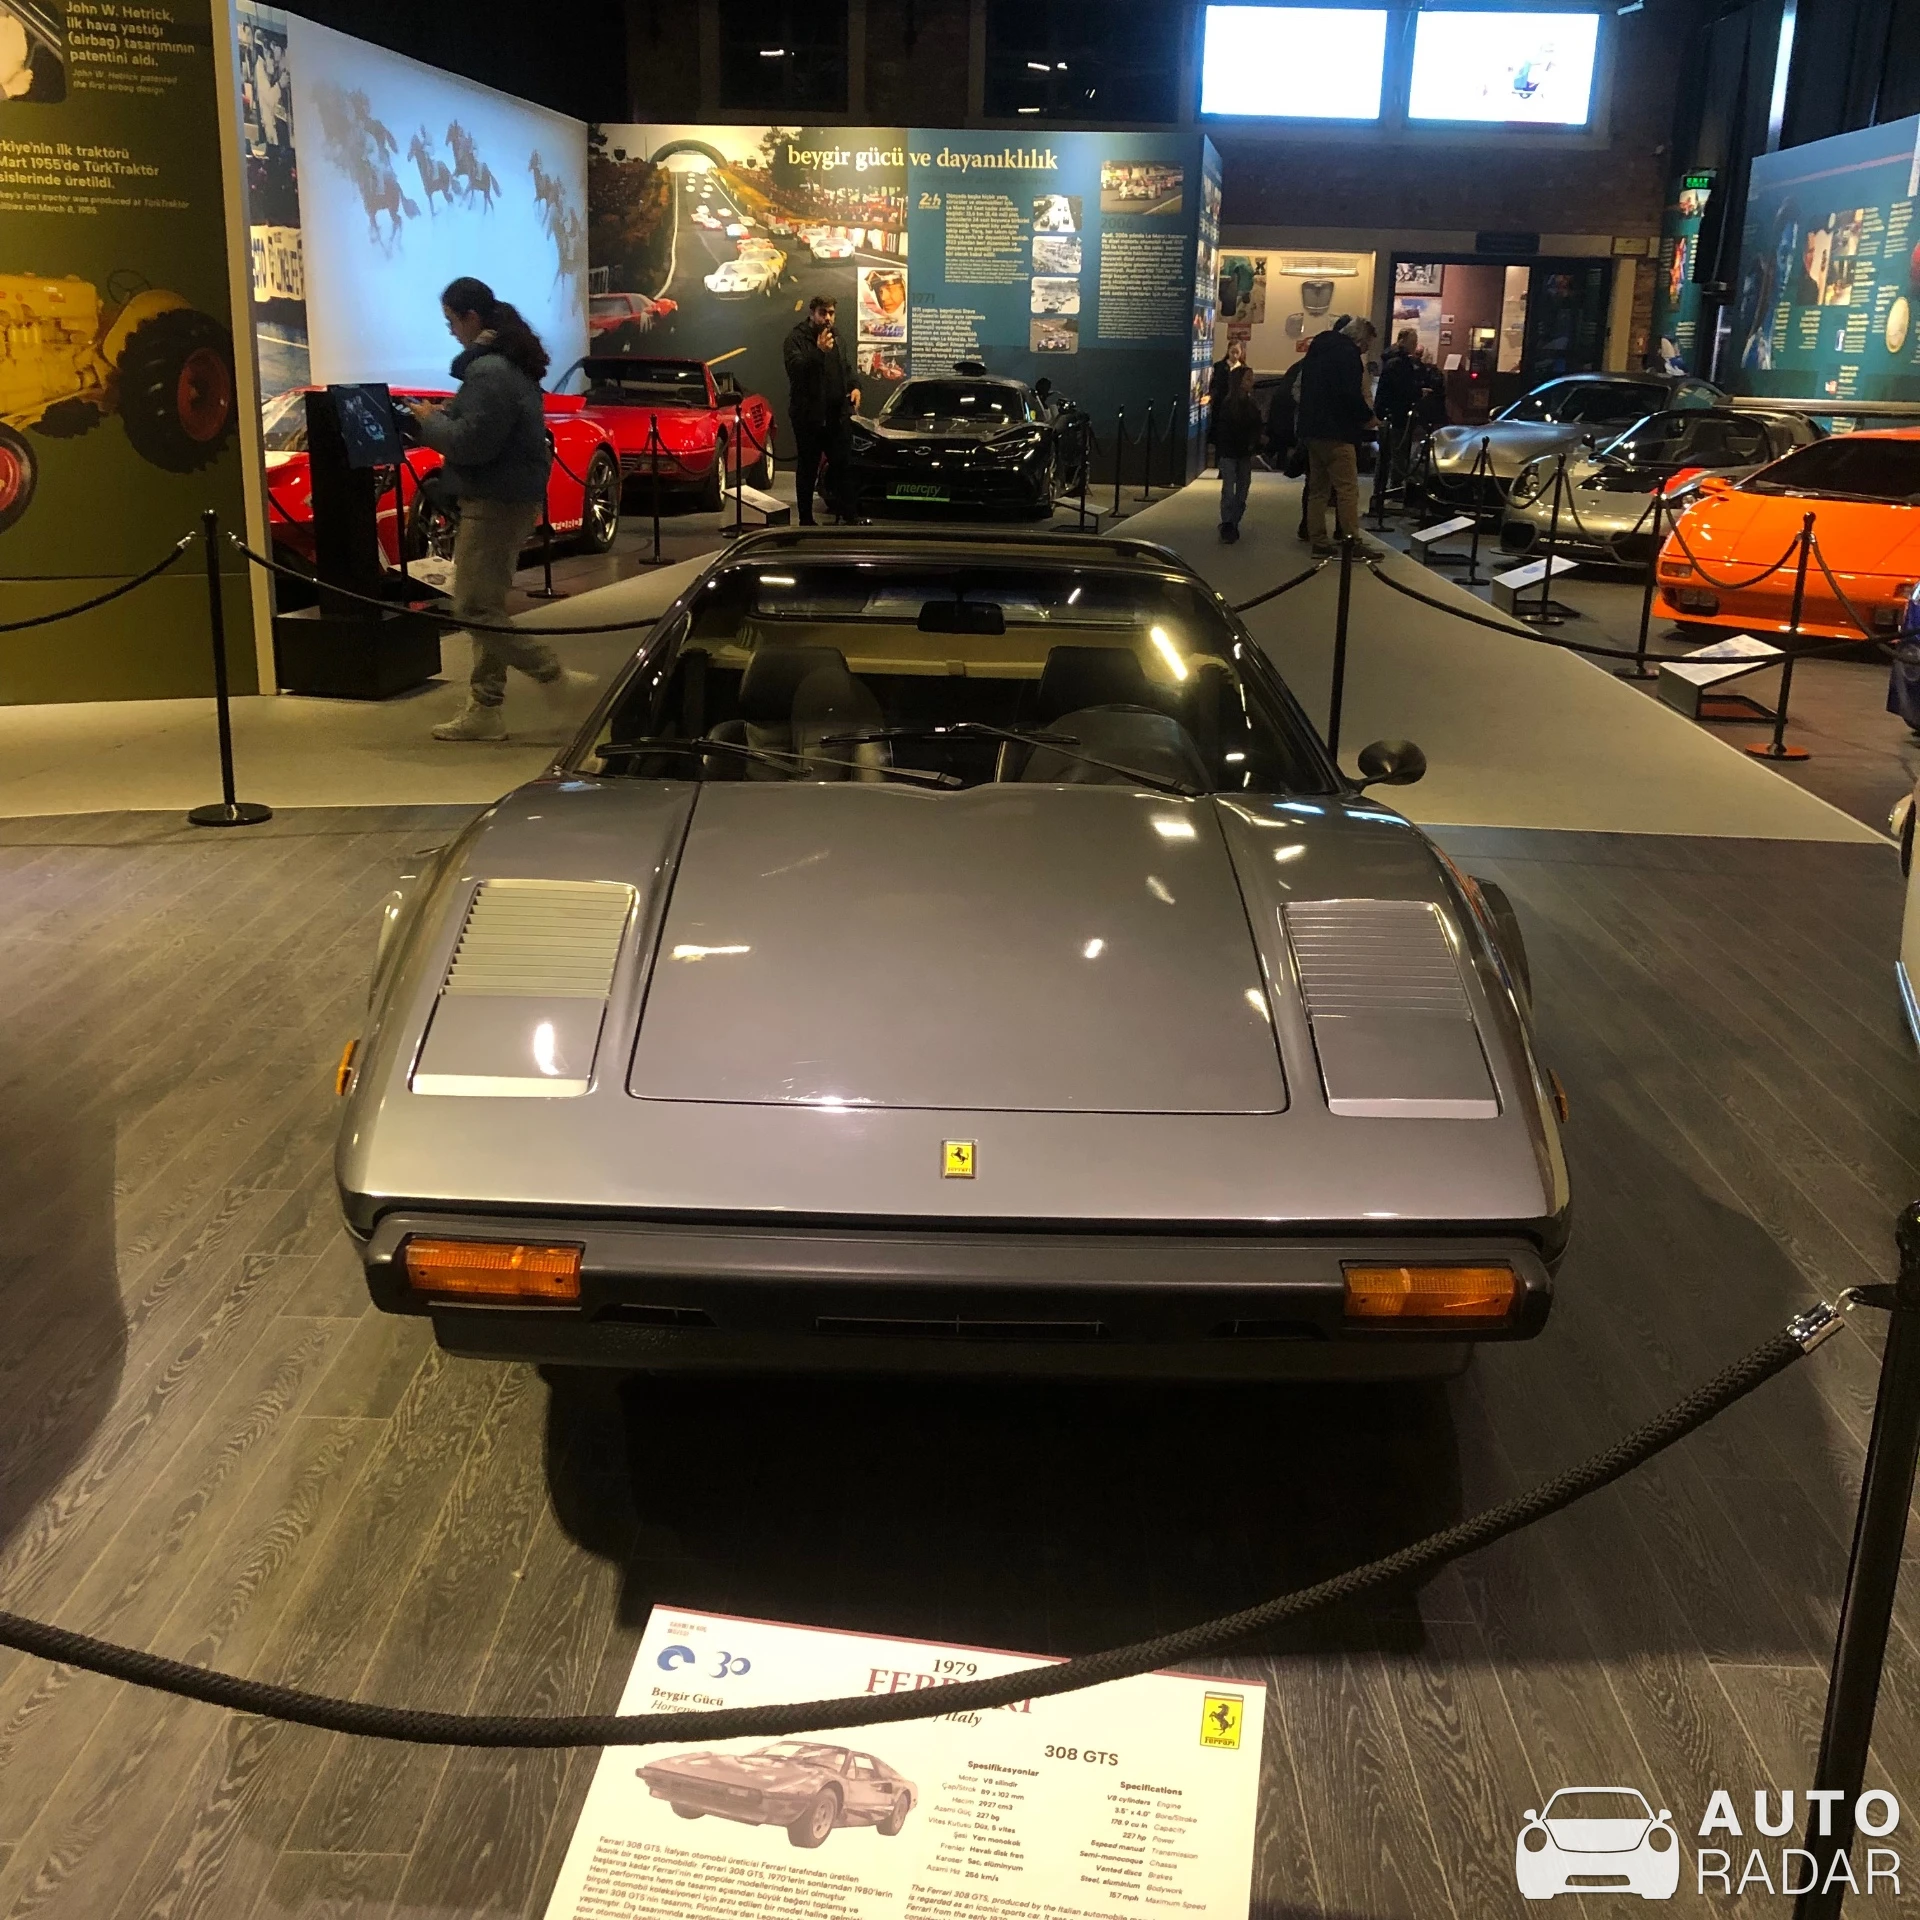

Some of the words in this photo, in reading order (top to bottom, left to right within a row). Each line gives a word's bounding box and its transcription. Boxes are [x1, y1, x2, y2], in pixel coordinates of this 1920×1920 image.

[66, 2, 98, 16] John
[101, 5, 119, 17] W.
[123, 6, 174, 23] Hetrick,
[66, 16, 82, 29] ilk
[86, 17, 117, 33] hava
[121, 21, 163, 39] yastığı
[68, 31, 120, 50] (airbag)
[70, 50, 128, 65] patentini
[132, 53, 158, 67] aldı.
[56, 143, 72, 156] ilk
[76, 145, 130, 159] traktörü
[788, 144, 850, 171] beygir
[855, 147, 904, 171] gücü
[909, 152, 931, 168] ve
[936, 147, 1058, 174] dayanıklılık
[31, 157, 80, 171] 1955'de
[83, 160, 160, 176] TürkTraktör
[65, 176, 115, 189] üretildi.
[932, 1658, 978, 1677] 1979
[651, 1686, 691, 1702] Beygir
[692, 1692, 724, 1706] Gücü
[1203, 1736, 1236, 1747] Ferrari
[1044, 1744, 1078, 1761] 308
[1082, 1749, 1119, 1767] GTS
[968, 1760, 1040, 1777] Spesifikasyonlar
[983, 1777, 993, 1785] V8
[995, 1779, 1018, 1788] silindir
[1120, 1781, 1183, 1796] Specifications
[978, 1800, 997, 1808] 2927
[997, 1803, 1014, 1811] cm3
[1118, 1796, 1151, 1806] cylinders
[1156, 1800, 1182, 1810] Engine
[976, 1811, 990, 1819] 227
[998, 1826, 1016, 1834] vites
[1153, 1823, 1187, 1835] Capacity
[988, 1837, 1021, 1847] monokok
[1122, 1831, 1136, 1840] 227
[1136, 1833, 1147, 1841] hp
[1152, 1835, 1175, 1845] Power
[599, 1835, 625, 1847] Ferrari
[626, 1841, 642, 1850] 308
[664, 1845, 689, 1858] İtalyan
[691, 1852, 727, 1863] otomobil
[728, 1857, 759, 1868] üreticisi
[761, 1861, 787, 1872] Ferrari
[788, 1866, 828, 1879] tarafından
[829, 1872, 860, 1883] üretilen
[969, 1845, 992, 1855] Havalı
[993, 1849, 1008, 1857] disk
[1009, 1851, 1025, 1859] fren
[1079, 1850, 1144, 1865] Semi-monocoque
[1149, 1859, 1178, 1869] Chassis
[1118, 1843, 1146, 1853] manual
[1151, 1847, 1199, 1860] Transmission
[620, 1850, 632, 1858] bir
[633, 1853, 651, 1862] spor
[701, 1862, 728, 1873] Ferrari
[729, 1867, 745, 1876] 308
[767, 1873, 805, 1885] 1970'lerin
[854, 1885, 893, 1898] 1980'lerin
[983, 1861, 1024, 1872] alüminyum
[1096, 1864, 1123, 1874] Vented
[1123, 1868, 1142, 1877] discs
[628, 1861, 651, 1871] kadar
[652, 1865, 692, 1877] Ferrari'nin
[704, 1874, 735, 1885] popüler
[736, 1879, 794, 1893] modellerinden
[795, 1887, 809, 1896] biri
[980, 1873, 999, 1882] km/s
[582, 1884, 608, 1895] Ferrari
[609, 1888, 627, 1898] 308
[589, 1864, 608, 1874] Hem
[609, 1869, 654, 1882] performans
[655, 1876, 674, 1885] hem
[675, 1879, 686, 1887] de
[757, 1891, 782, 1902] büyük
[783, 1896, 811, 1907] beğeni
[812, 1900, 847, 1913] toplamış
[1102, 1878, 1141, 1889] aluminium
[1146, 1883, 1183, 1895] Bodywork
[586, 1874, 610, 1886] birçok
[612, 1879, 648, 1891] otomobil
[649, 1885, 702, 1900] koleksiyoneri
[702, 1894, 717, 1903] için
[718, 1897, 736, 1906] arzu
[737, 1900, 763, 1910] edilen
[764, 1903, 776, 1911] bir
[776, 1905, 803, 1915] model
[804, 1909, 828, 1919] haline
[911, 1883, 925, 1892] The
[926, 1886, 952, 1896] Ferrari
[953, 1890, 970, 1899] 308
[971, 1893, 990, 1903] GTS,
[991, 1896, 1030, 1909] produced
[1031, 1902, 1041, 1911] by
[1043, 1904, 1057, 1912] the
[1057, 1905, 1082, 1917] Italian
[1109, 1891, 1122, 1899] 157
[1122, 1893, 1139, 1902] mph
[1181, 1901, 1207, 1911] Speed
[575, 1905, 594, 1914] spor
[905, 1903, 931, 1914] Ferrari
[932, 1906, 952, 1916] from
[953, 1910, 966, 1919] the
[916, 1895, 953, 1907] regarded
[953, 1901, 962, 1909] as
[975, 1904, 1000, 1914] iconic
[1001, 1907, 1026, 1918] sports
